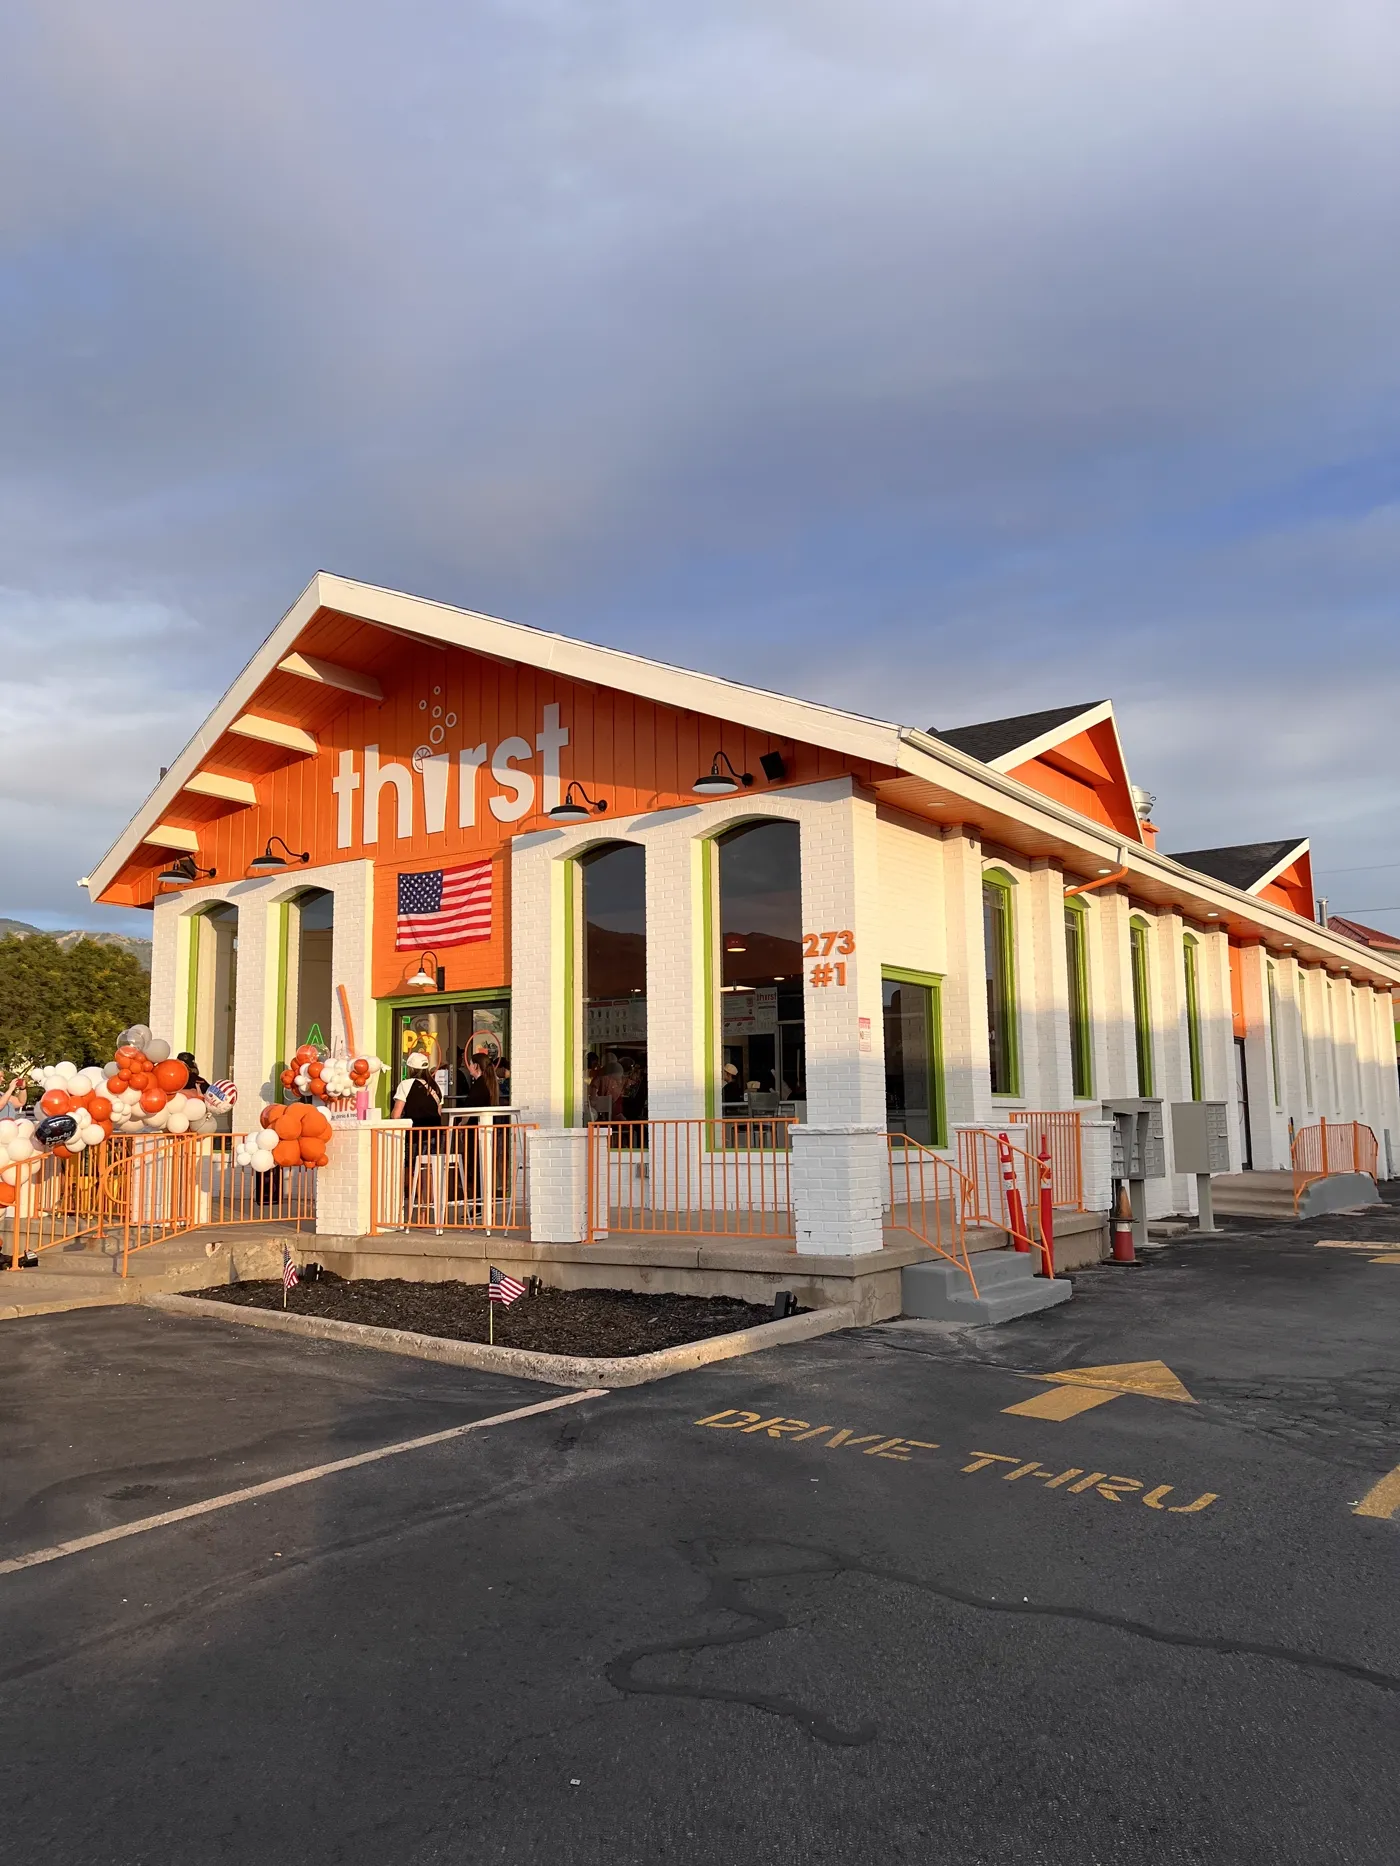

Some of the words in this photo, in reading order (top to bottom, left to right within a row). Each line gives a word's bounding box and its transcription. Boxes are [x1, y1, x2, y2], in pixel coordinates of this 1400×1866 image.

[332, 702, 569, 849] thirst
[803, 930, 856, 958] 273
[810, 962, 846, 987] #1
[694, 1409, 941, 1461] DRIVE
[960, 1451, 1221, 1512] THRU
